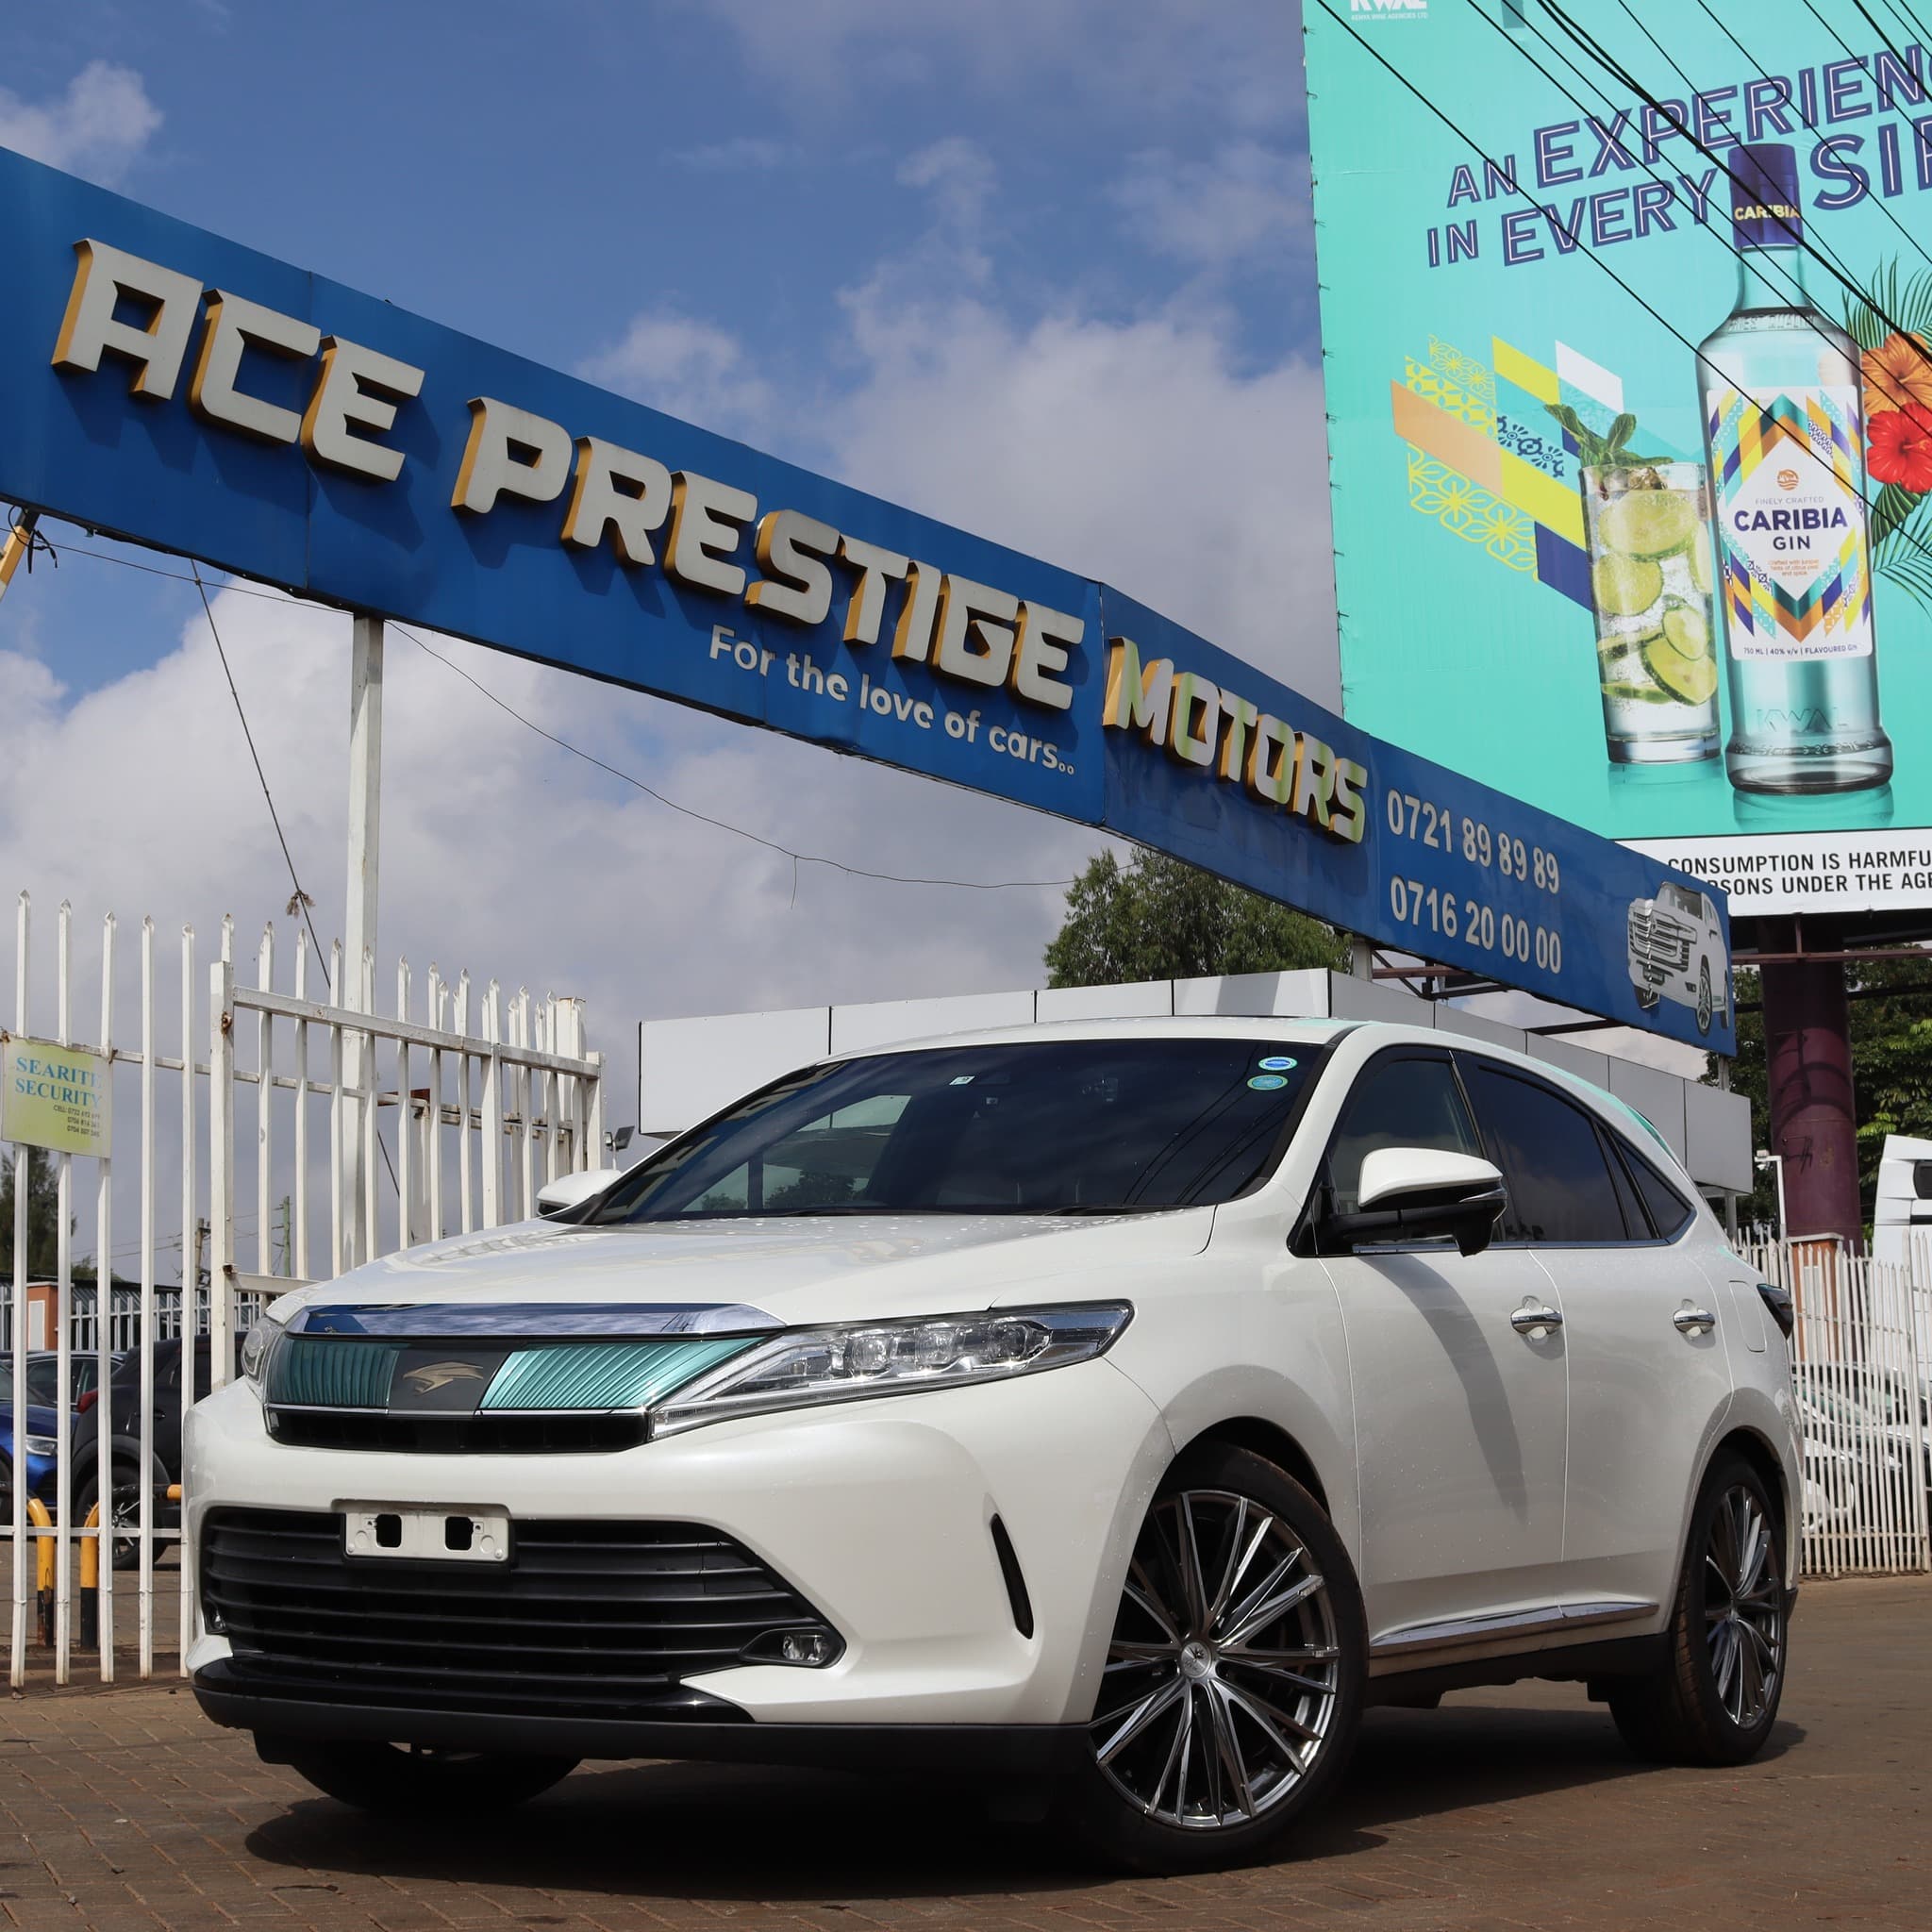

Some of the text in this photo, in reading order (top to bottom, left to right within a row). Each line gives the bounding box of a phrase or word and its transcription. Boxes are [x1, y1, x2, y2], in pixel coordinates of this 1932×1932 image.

[1447, 42, 1932, 208] AN EXPERIEN
[1427, 219, 1479, 268] IN
[1501, 168, 1719, 267] EVERY
[1756, 496, 1824, 506] FINELY CRAFTED
[1734, 507, 1848, 531] CARIBIA
[51, 237, 1368, 843] ACE PRESTIGE MOTORS
[1773, 535, 1810, 550] GIN
[1805, 645, 1846, 655] FLAVOURED
[709, 624, 776, 677] For
[786, 651, 849, 702] the
[859, 673, 935, 729] love
[944, 708, 982, 743] of
[1388, 789, 1560, 894] 0721 89 89 89
[1822, 852, 1840, 870] IS
[1848, 849, 1931, 869] HARMFU
[1781, 874, 1848, 894] UNDER
[1855, 873, 1893, 891] THE
[1390, 875, 1562, 974] 0716 20 00 00
[15, 1078, 102, 1109] SECURITY
